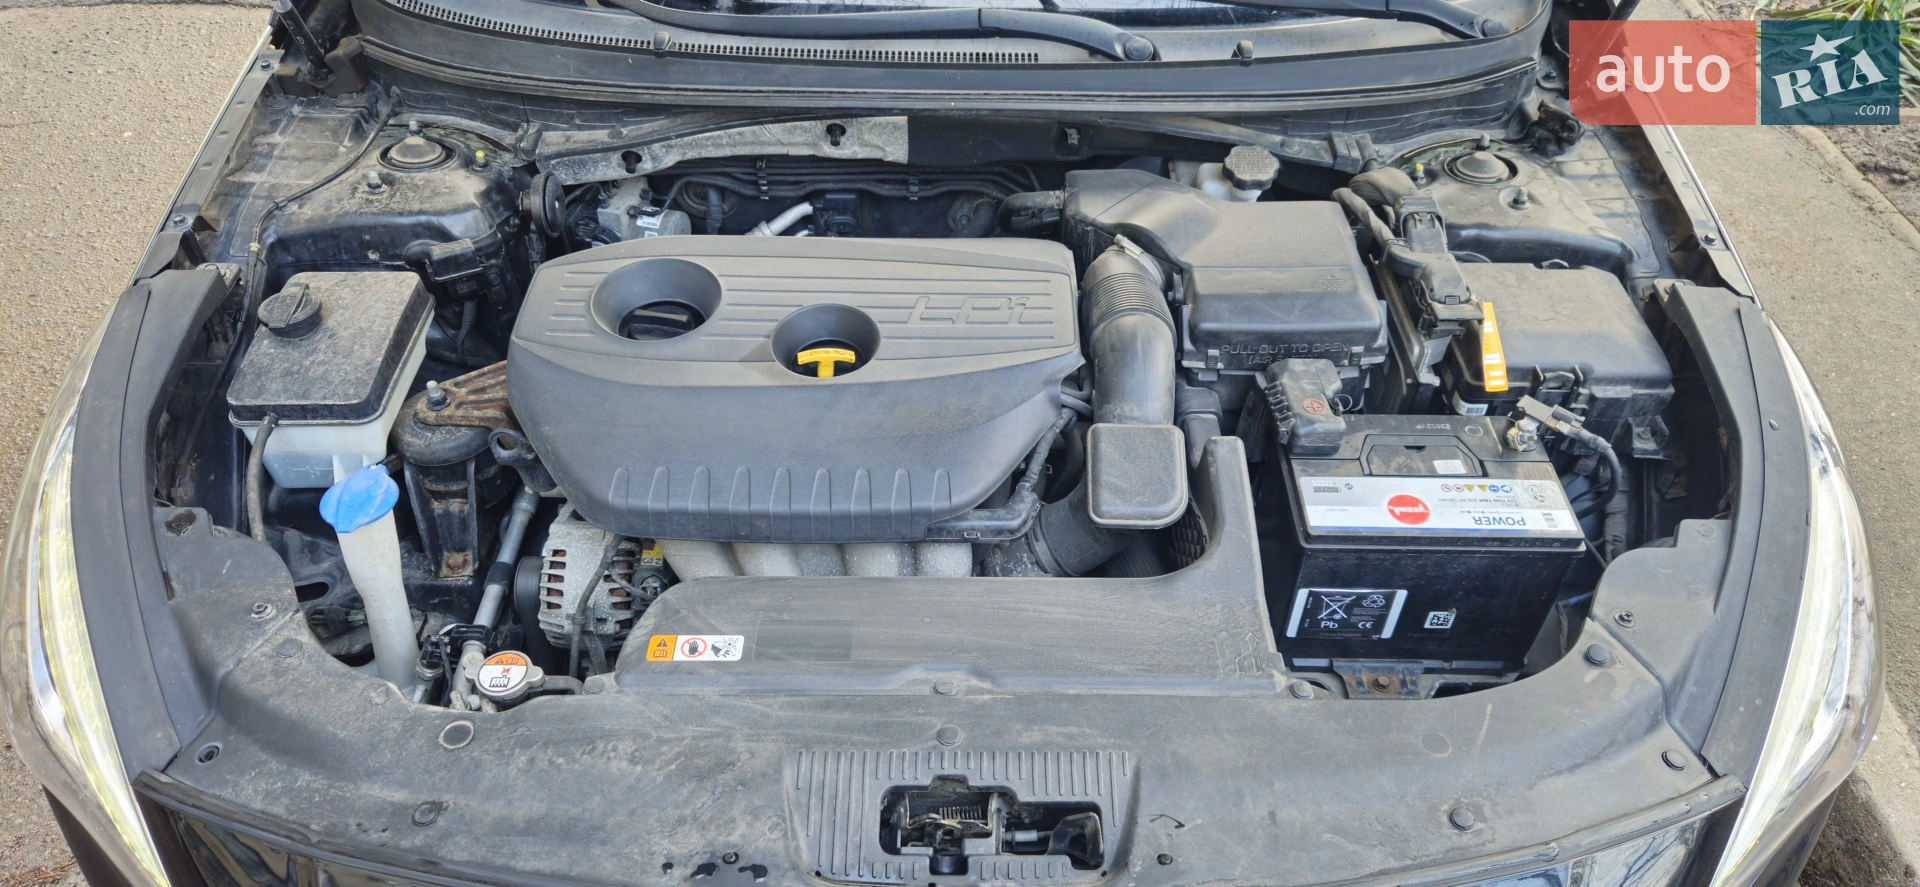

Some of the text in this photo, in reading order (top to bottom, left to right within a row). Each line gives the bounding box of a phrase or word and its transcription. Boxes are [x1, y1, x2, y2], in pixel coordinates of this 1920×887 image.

[1220, 342, 1350, 354] PULL OUT TO OPEN
[1472, 516, 1526, 526] POWER
[1320, 620, 1338, 629] Pb
